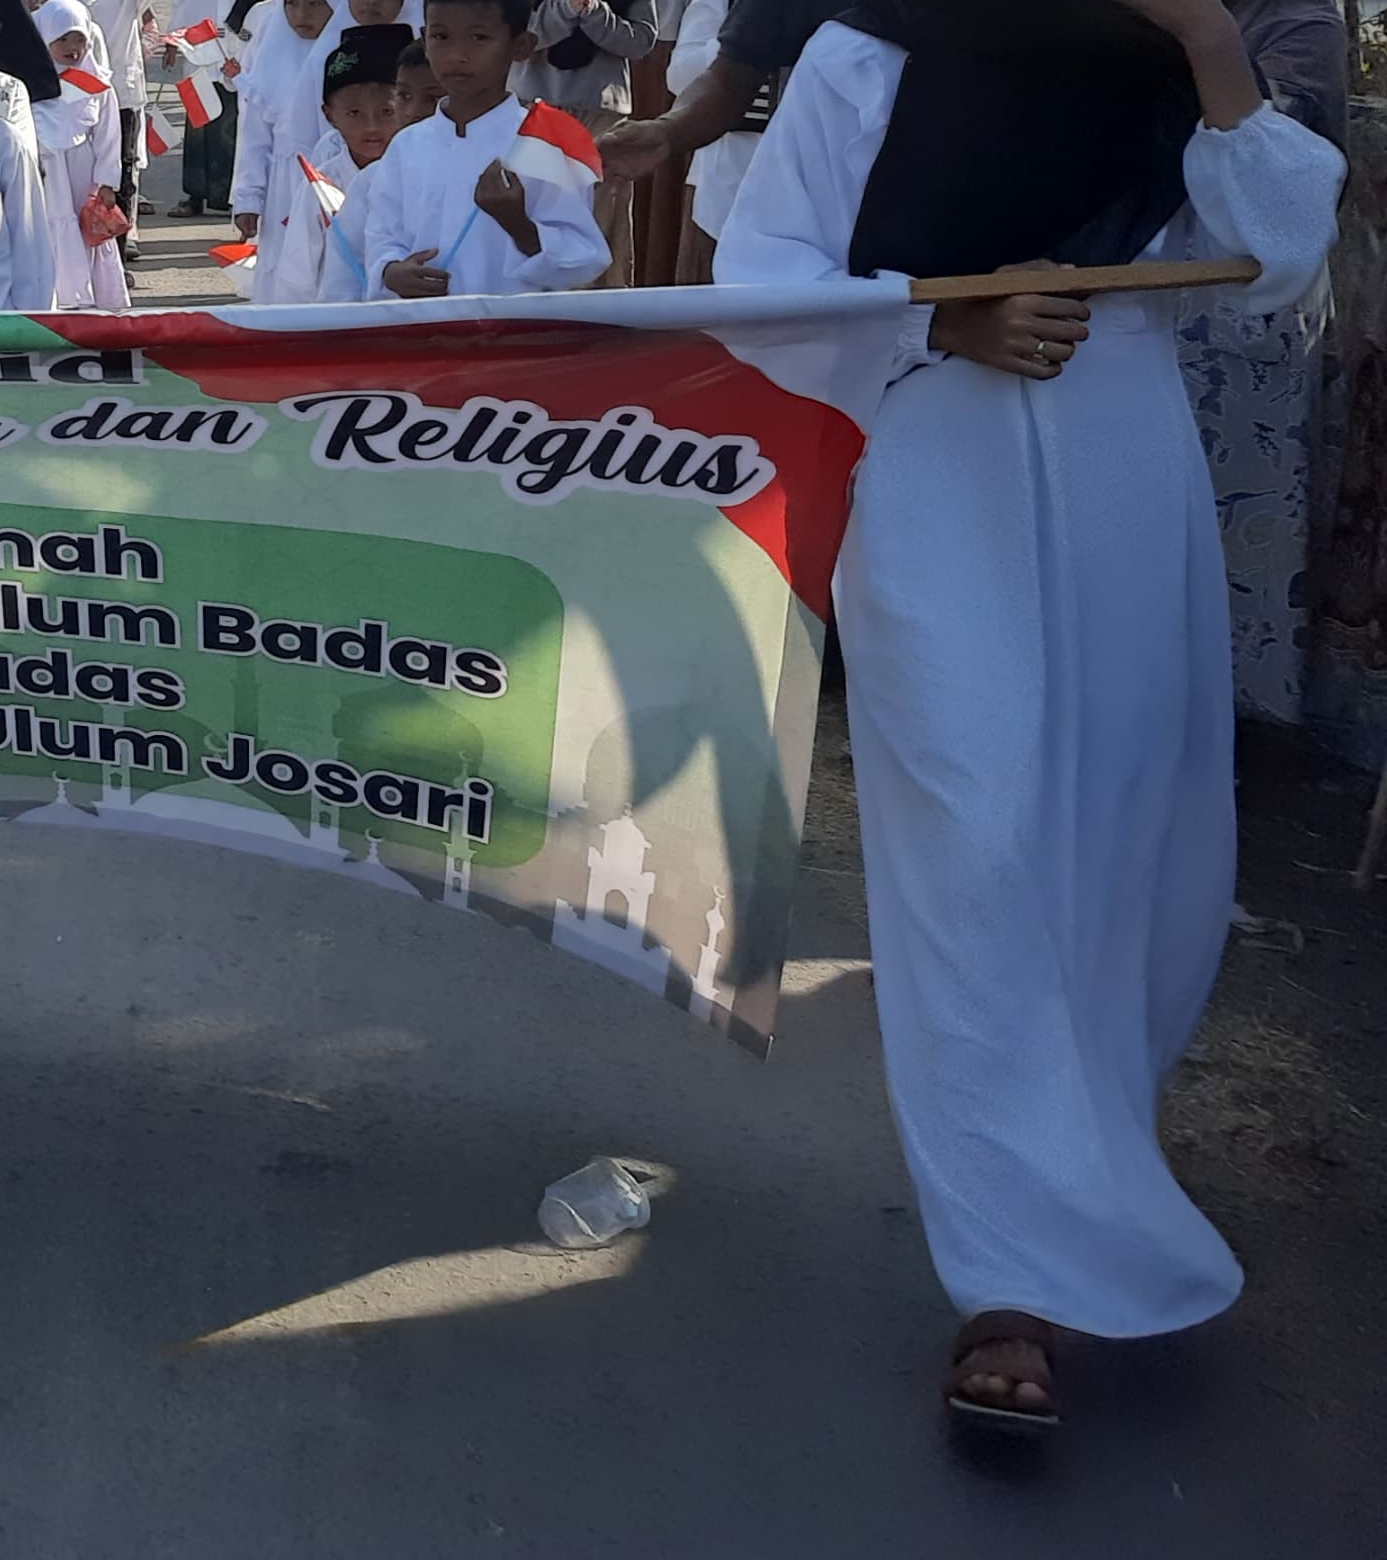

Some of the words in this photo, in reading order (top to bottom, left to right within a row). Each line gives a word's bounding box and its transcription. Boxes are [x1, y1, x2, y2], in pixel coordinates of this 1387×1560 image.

[50, 401, 253, 445] dan
[292, 394, 760, 495] Religius
[199, 603, 506, 696] Badas
[203, 735, 492, 842] Josari
